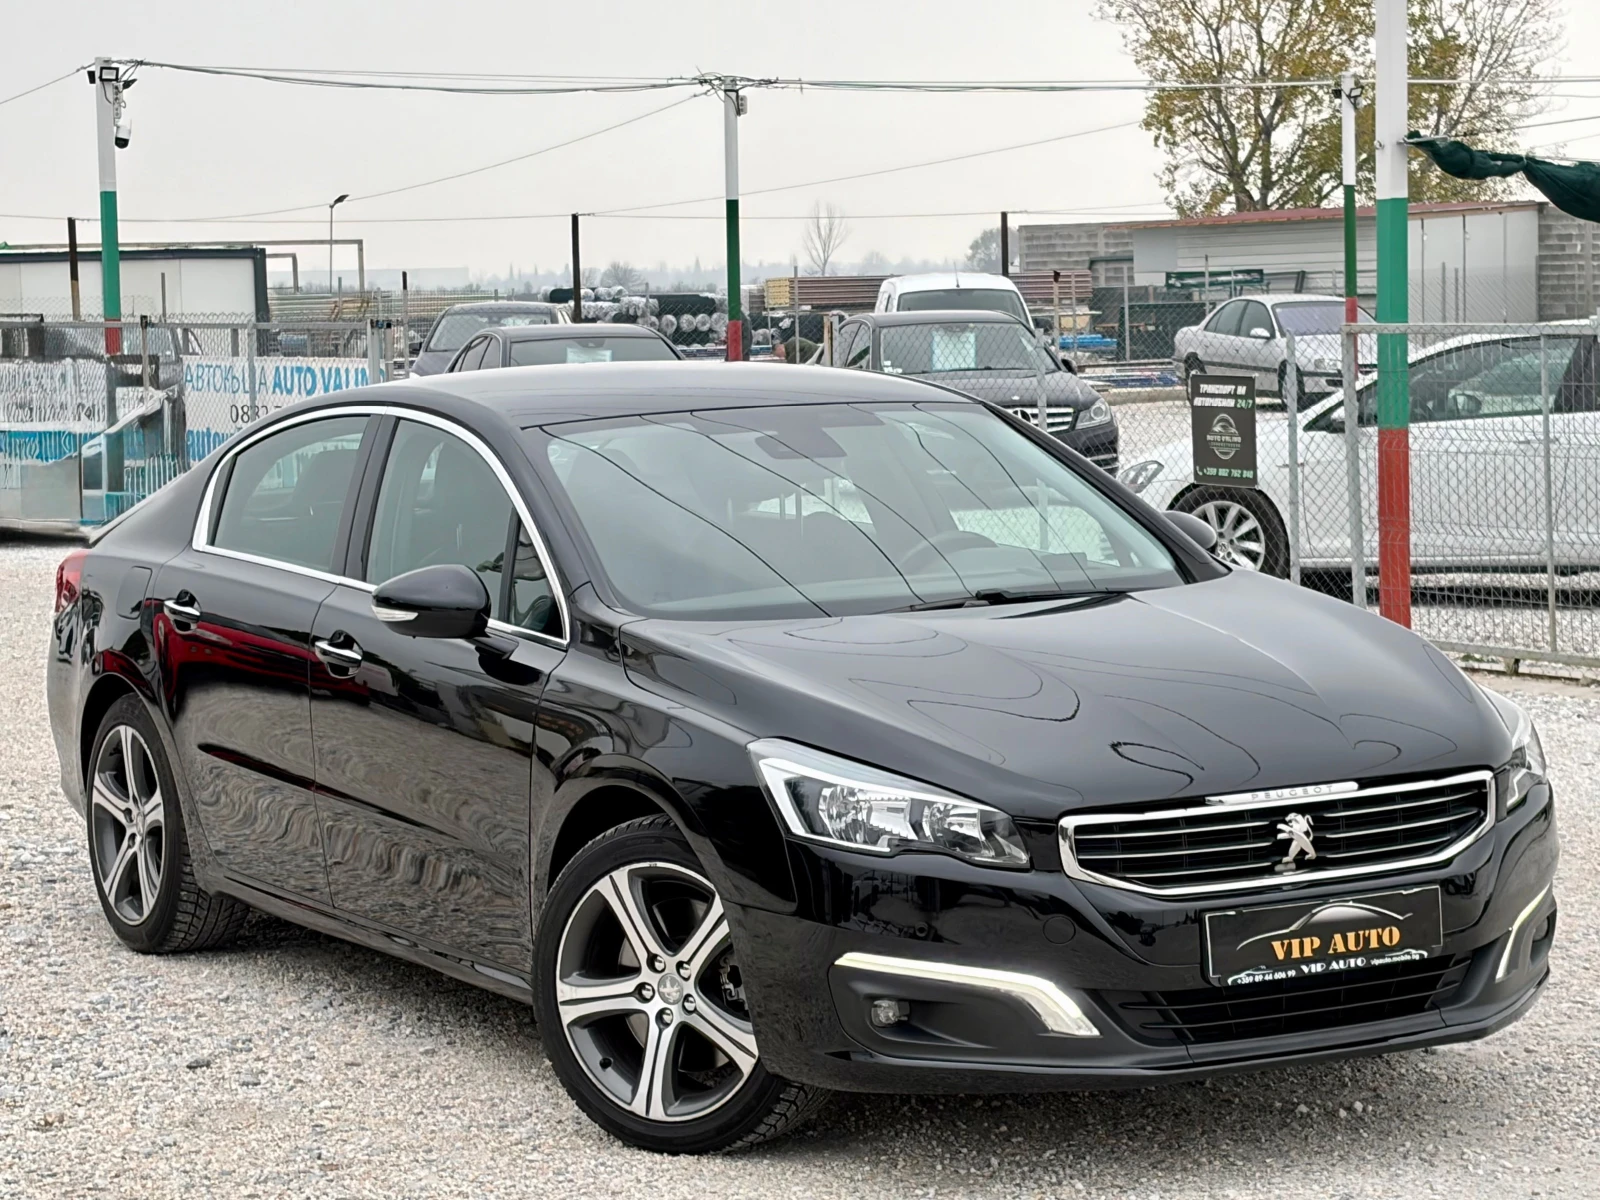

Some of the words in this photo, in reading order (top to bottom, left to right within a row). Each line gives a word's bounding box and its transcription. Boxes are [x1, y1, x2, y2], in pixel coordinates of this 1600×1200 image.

[272, 365, 317, 396] AUTO
[1236, 398, 1253, 409] 24/7
[1251, 785, 1333, 800] PEUGEOT
[1270, 936, 1321, 961] VIP
[1327, 925, 1401, 954] AUTO
[1300, 962, 1326, 975] VIP
[1328, 956, 1366, 970] AUTO
